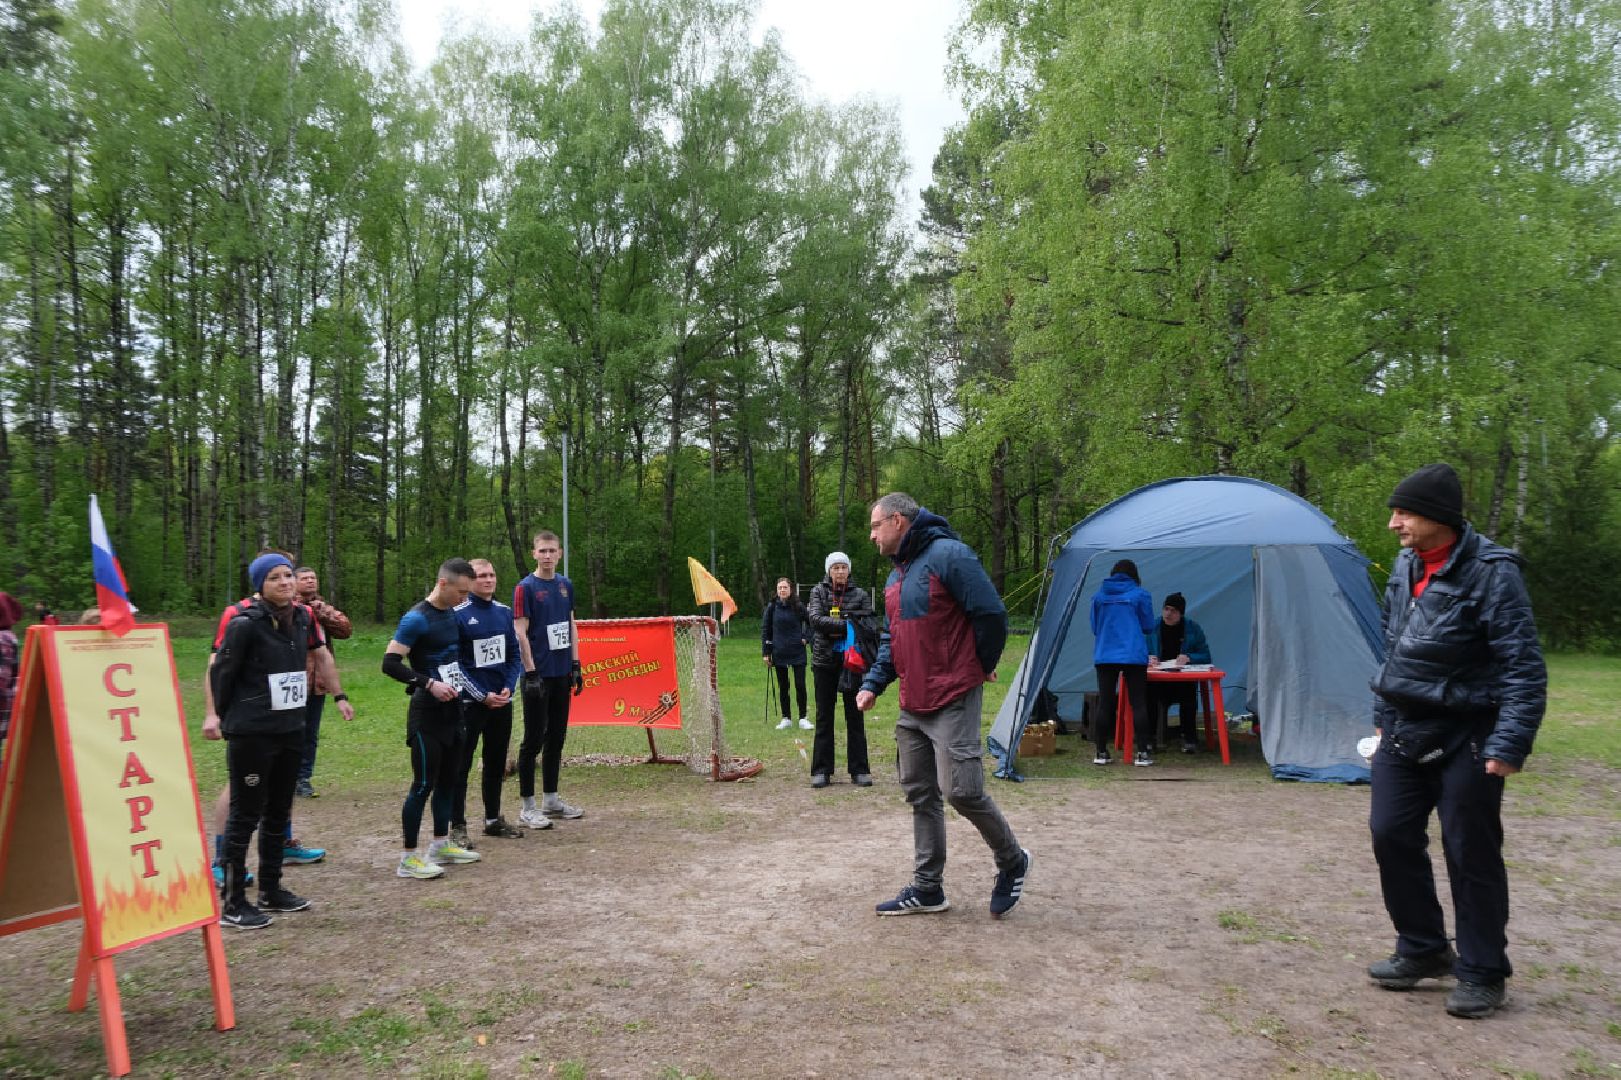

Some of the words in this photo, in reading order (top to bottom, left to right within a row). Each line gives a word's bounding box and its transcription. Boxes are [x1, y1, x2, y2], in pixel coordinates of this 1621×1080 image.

[607, 660, 661, 682] ПОБЕДЫ!
[613, 698, 626, 717] 9
[103, 663, 162, 878] СТАРТ
